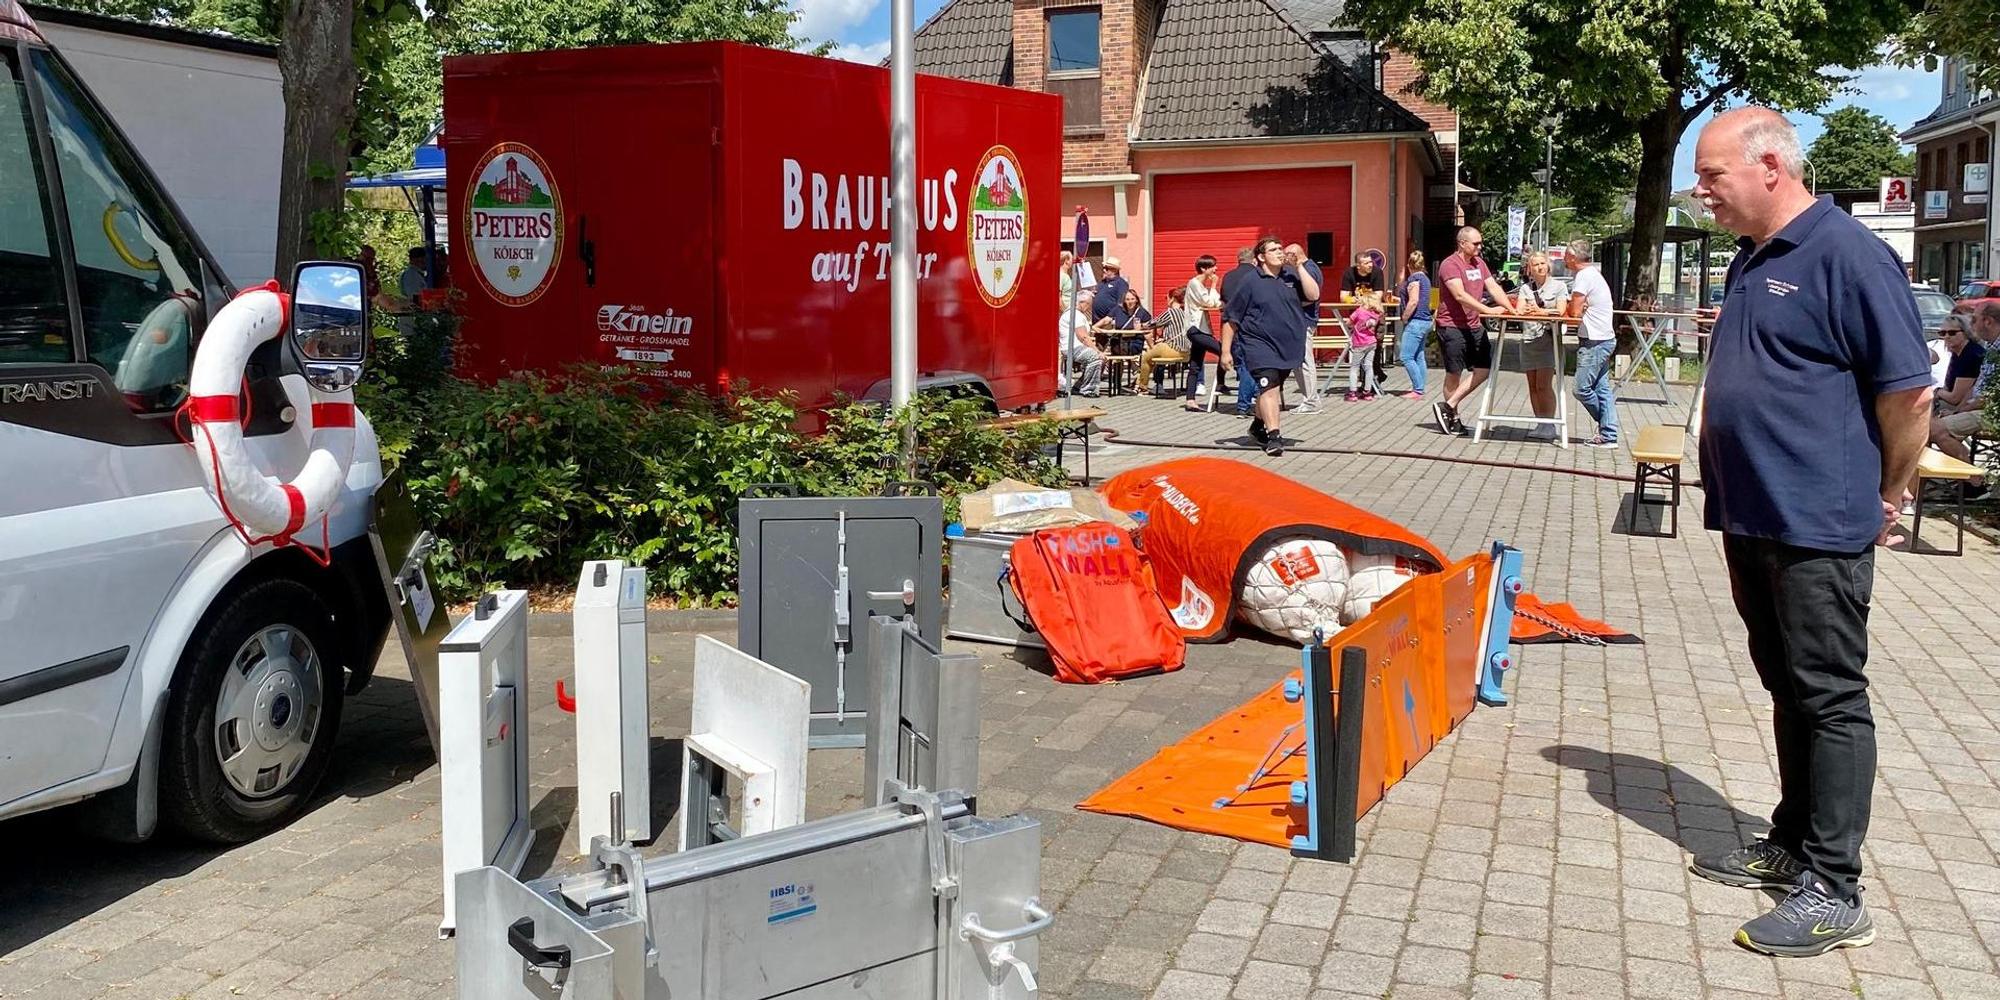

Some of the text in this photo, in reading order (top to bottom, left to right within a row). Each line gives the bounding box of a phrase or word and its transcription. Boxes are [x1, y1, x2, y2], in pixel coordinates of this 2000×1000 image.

[783, 159, 958, 232] BRAUHUS
[474, 211, 552, 239] PETERS
[975, 214, 1023, 240] PETERS
[493, 245, 534, 260] KÖLSCH
[873, 241, 938, 281] Tr
[986, 247, 1012, 262] KÖLSCH
[811, 241, 869, 293] auf
[599, 304, 693, 335] Knein
[634, 351, 655, 361] 1893
[0, 379, 98, 404] RANSIT
